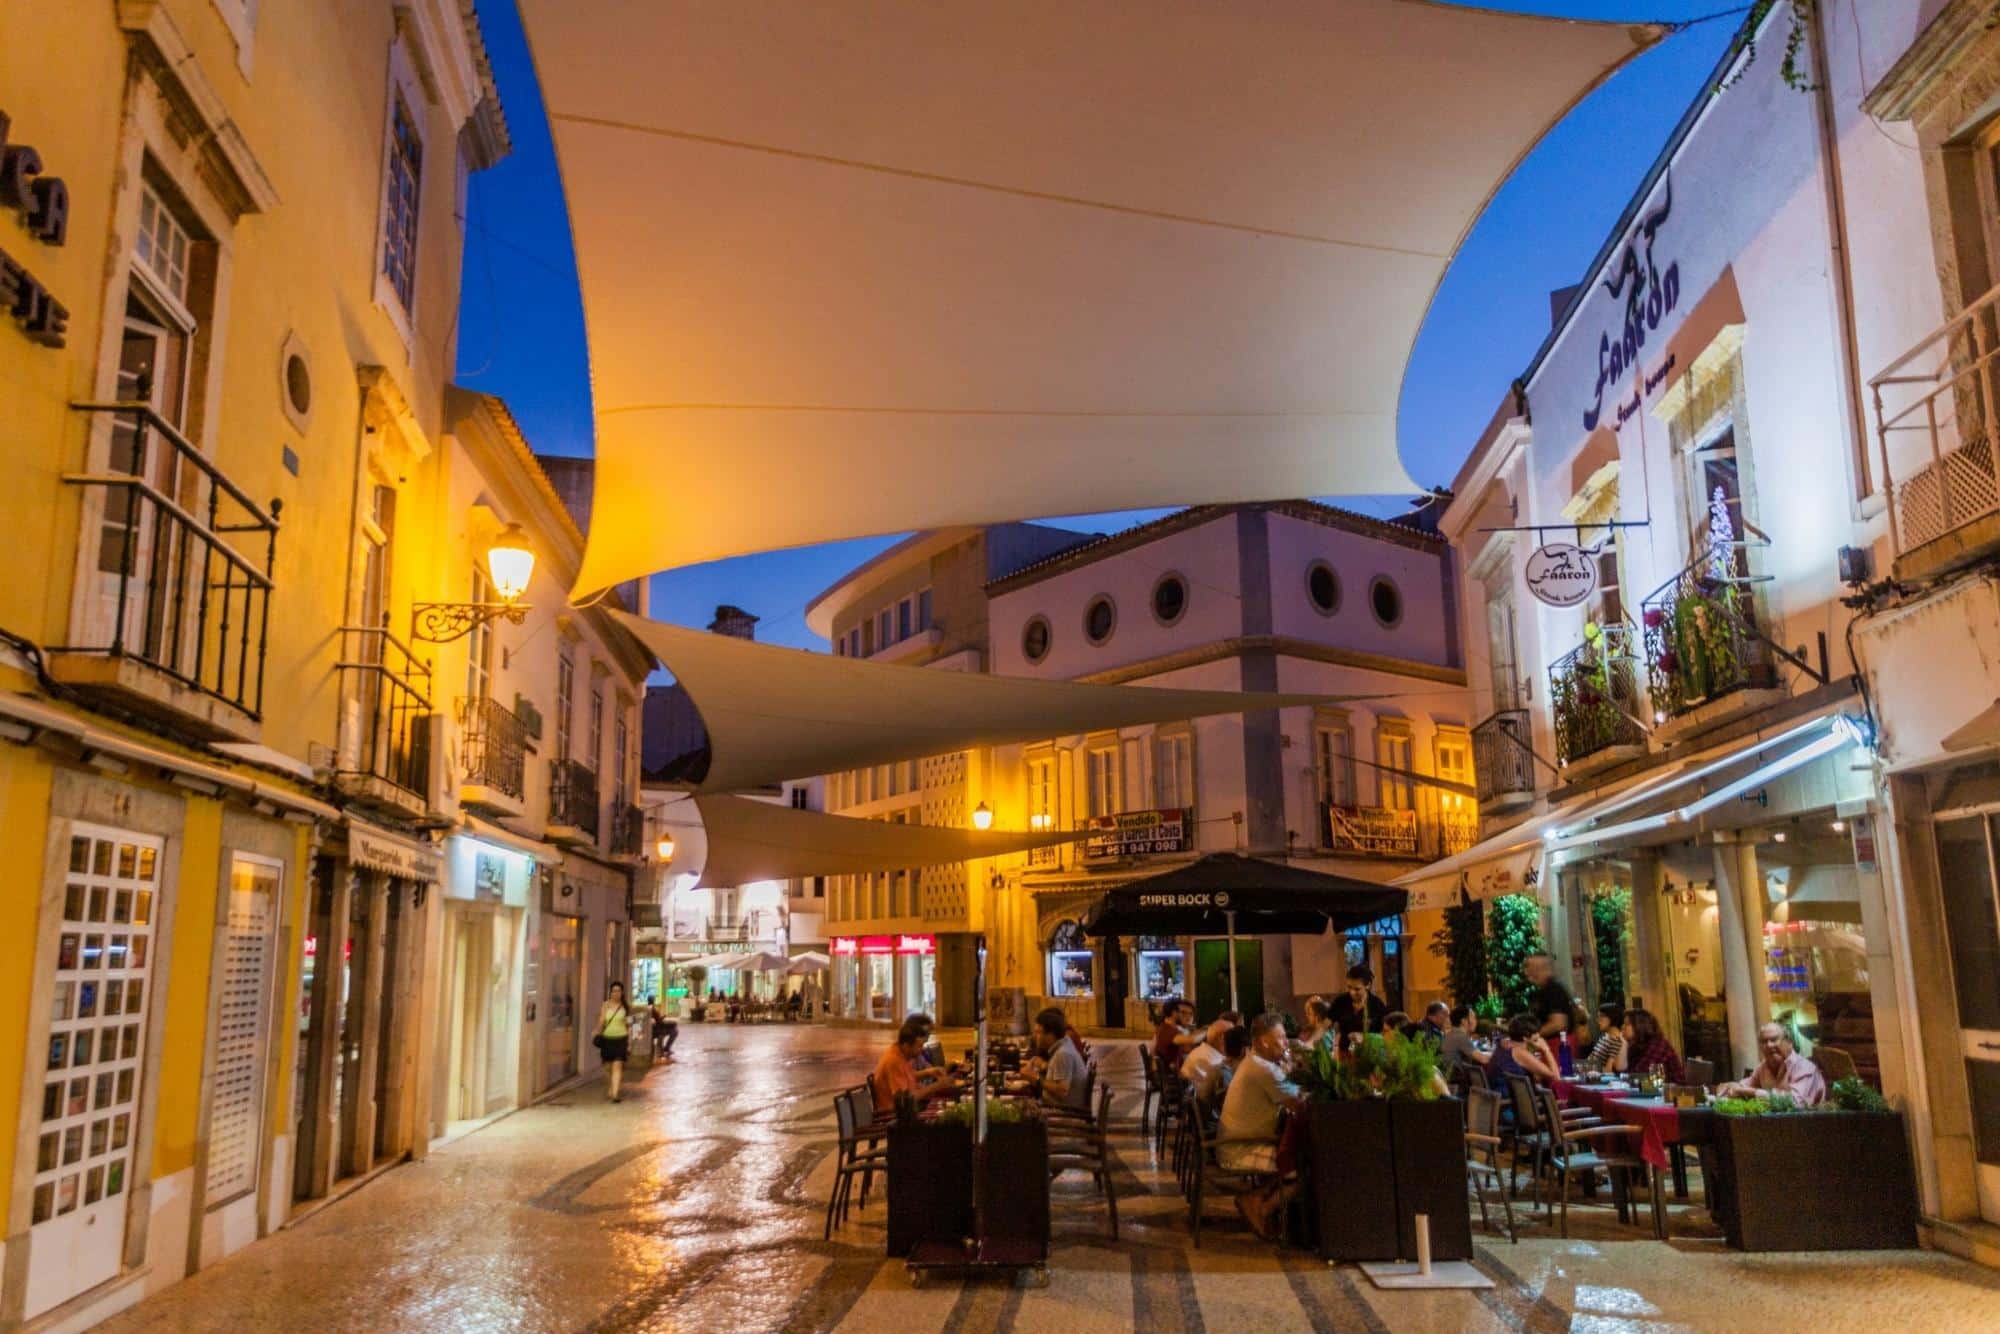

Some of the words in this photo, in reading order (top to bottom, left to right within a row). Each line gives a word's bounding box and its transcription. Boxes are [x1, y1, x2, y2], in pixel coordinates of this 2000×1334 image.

[1116, 813, 1156, 828] Vendido
[1139, 895, 1176, 905] SUPER
[1178, 894, 1210, 905] BOCK
